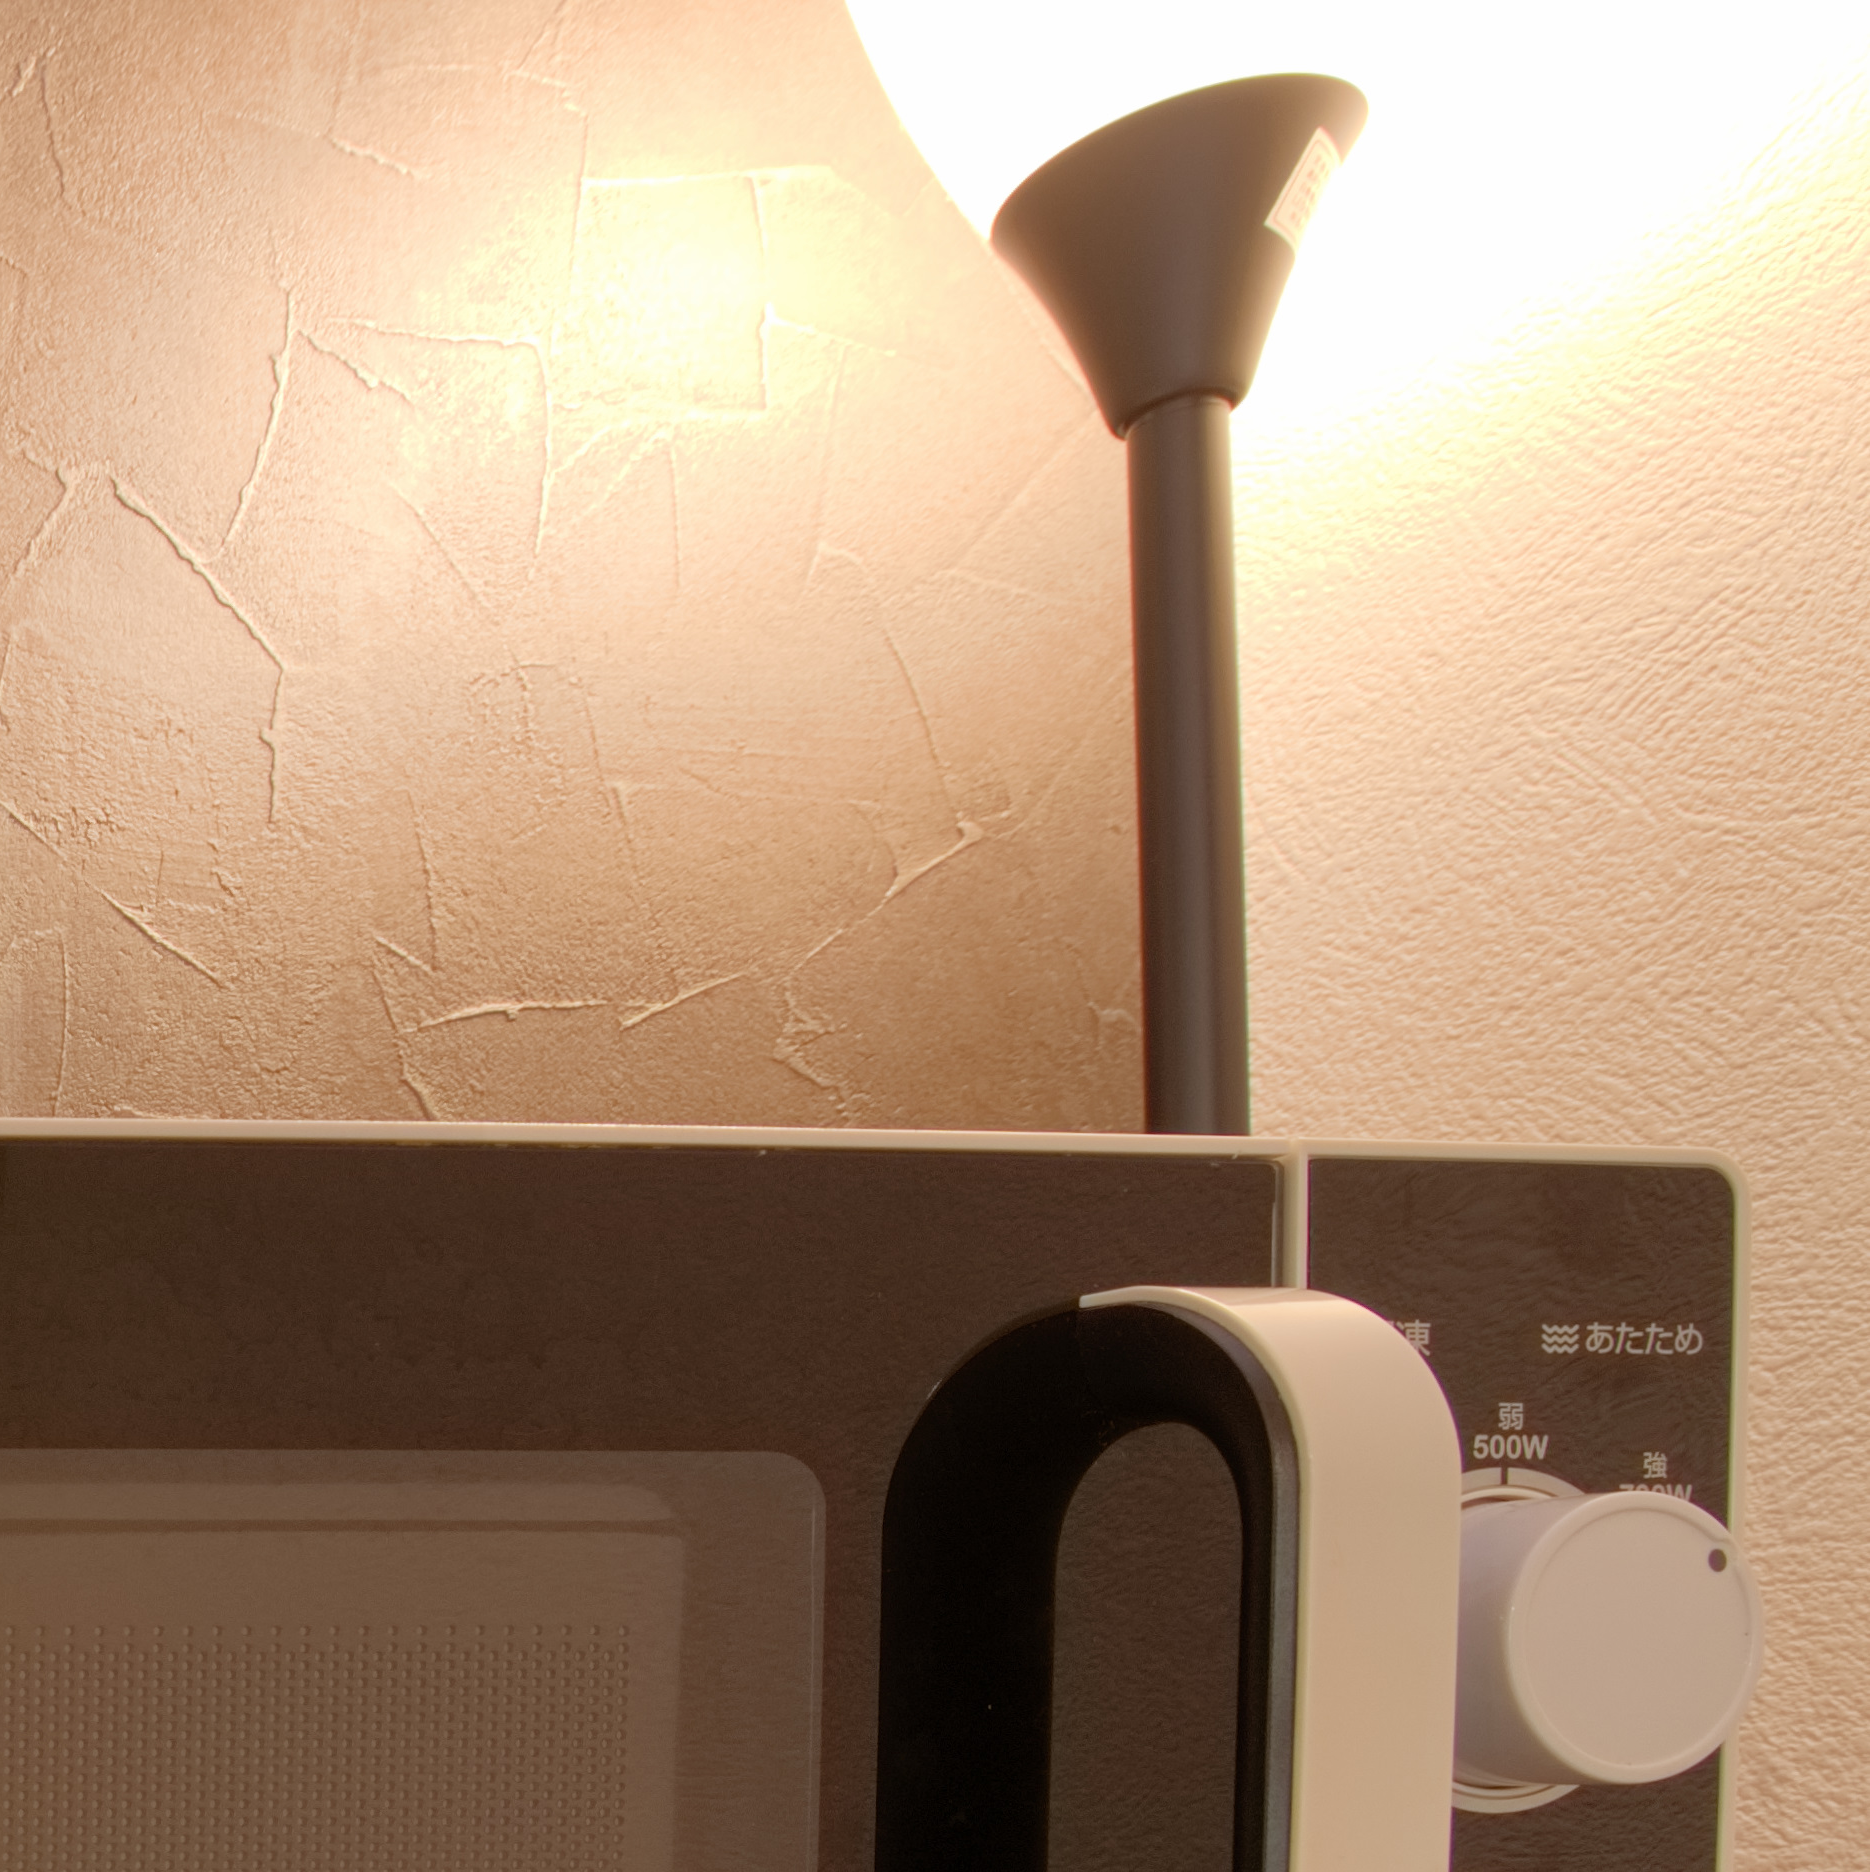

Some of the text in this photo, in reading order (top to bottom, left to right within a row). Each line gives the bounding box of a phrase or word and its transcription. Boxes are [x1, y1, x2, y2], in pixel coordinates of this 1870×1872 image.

[1585, 1322, 1704, 1355] あたため
[1498, 1402, 1524, 1430] 弱
[1473, 1434, 1549, 1460] 500W
[1643, 1452, 1668, 1479] 強
